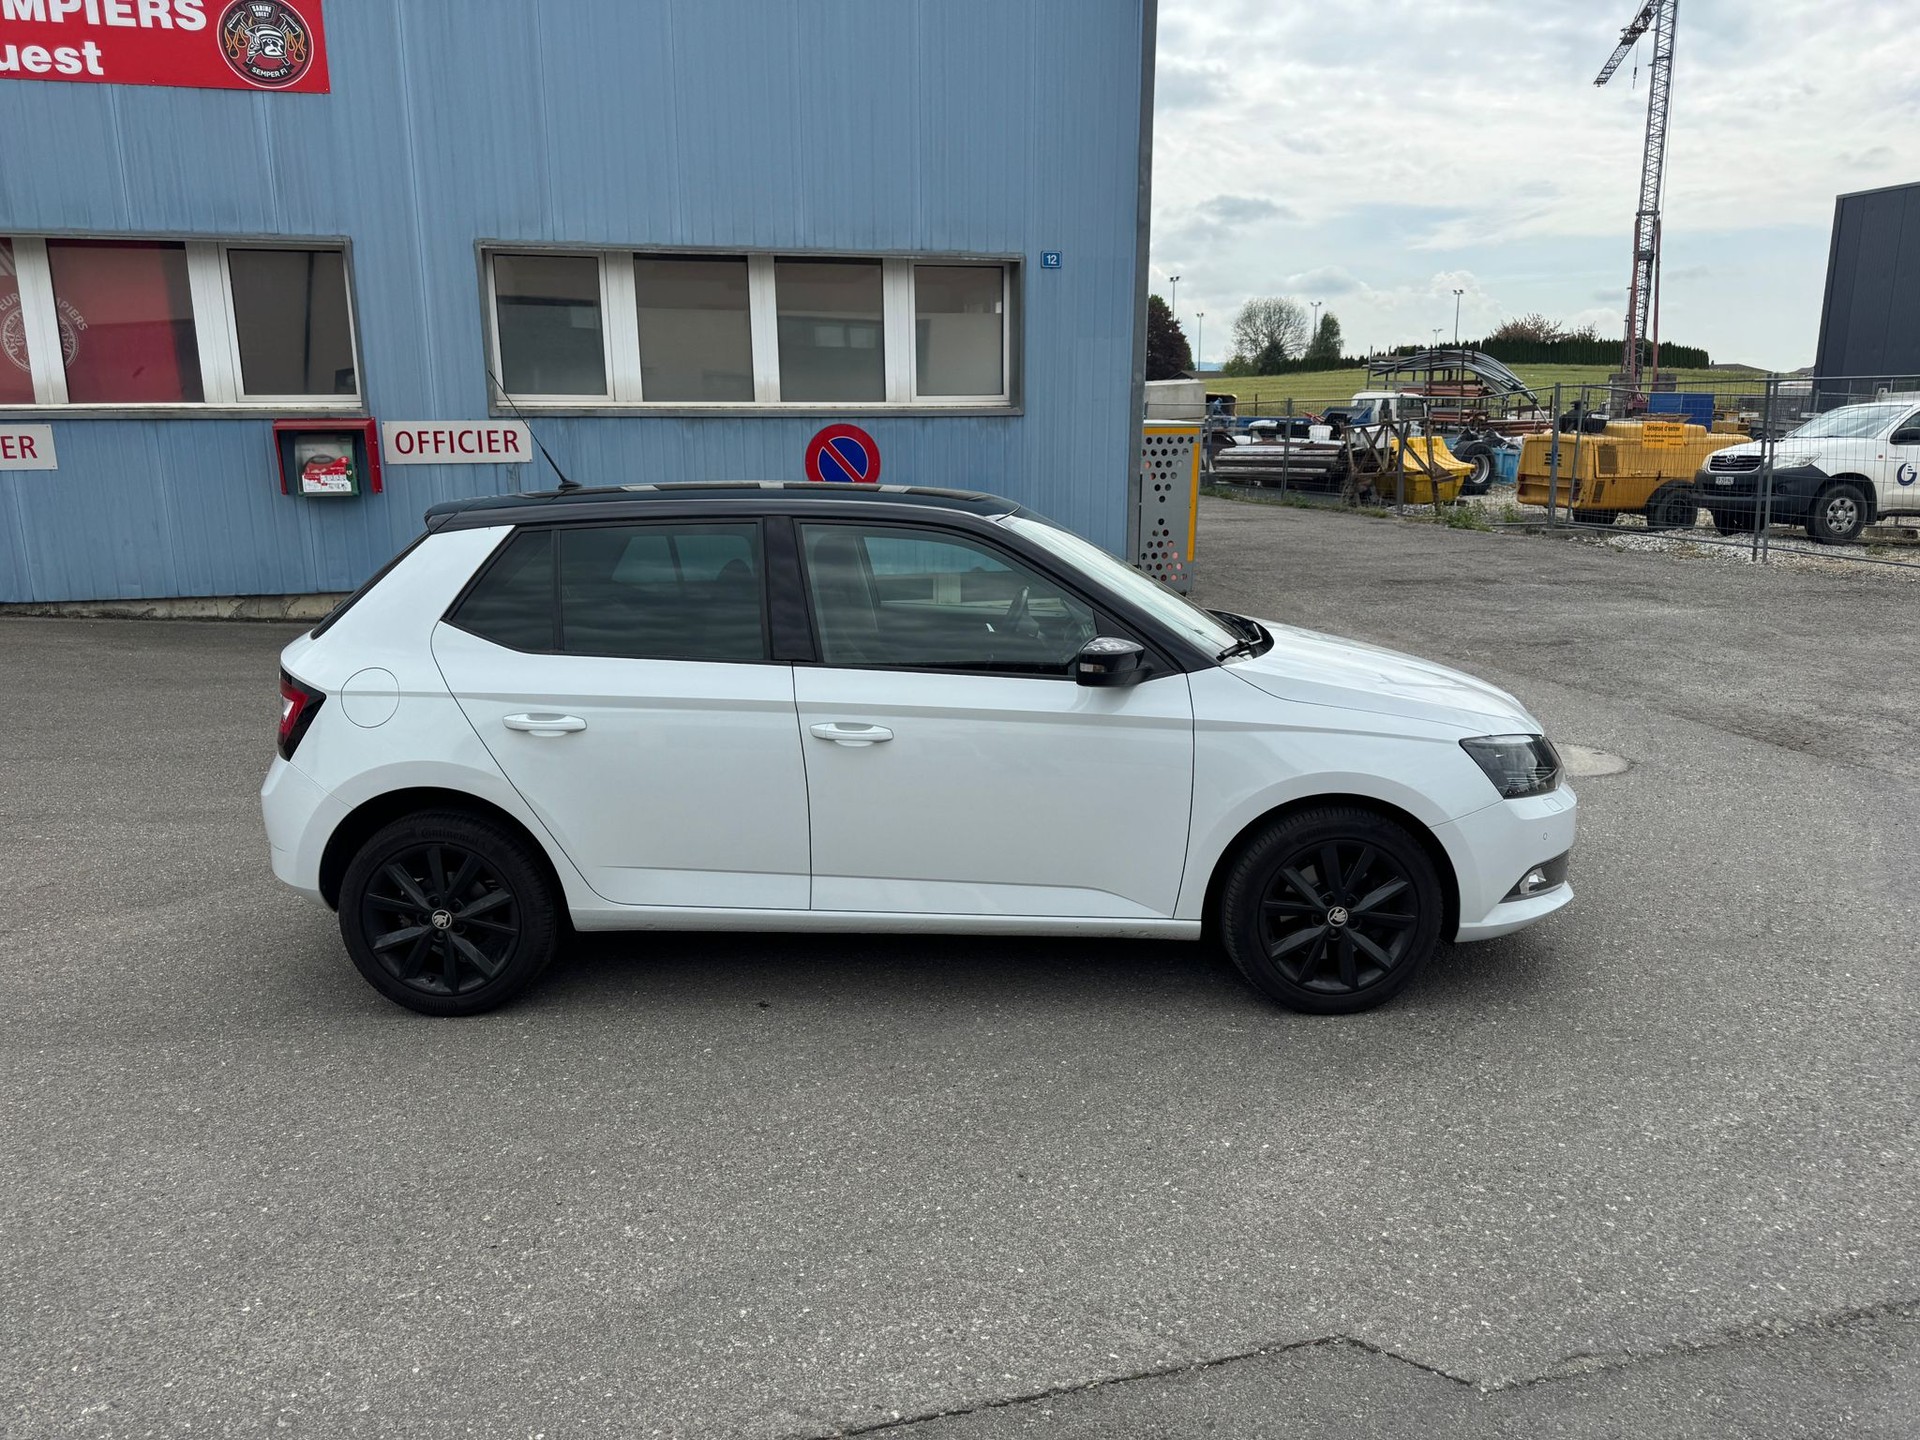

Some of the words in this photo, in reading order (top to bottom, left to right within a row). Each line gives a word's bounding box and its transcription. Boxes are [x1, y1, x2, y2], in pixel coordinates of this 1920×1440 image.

[251, 66, 281, 78] SEMPER
[280, 68, 288, 76] FI
[1046, 254, 1057, 265] 12
[394, 430, 520, 455] OFFICIER
